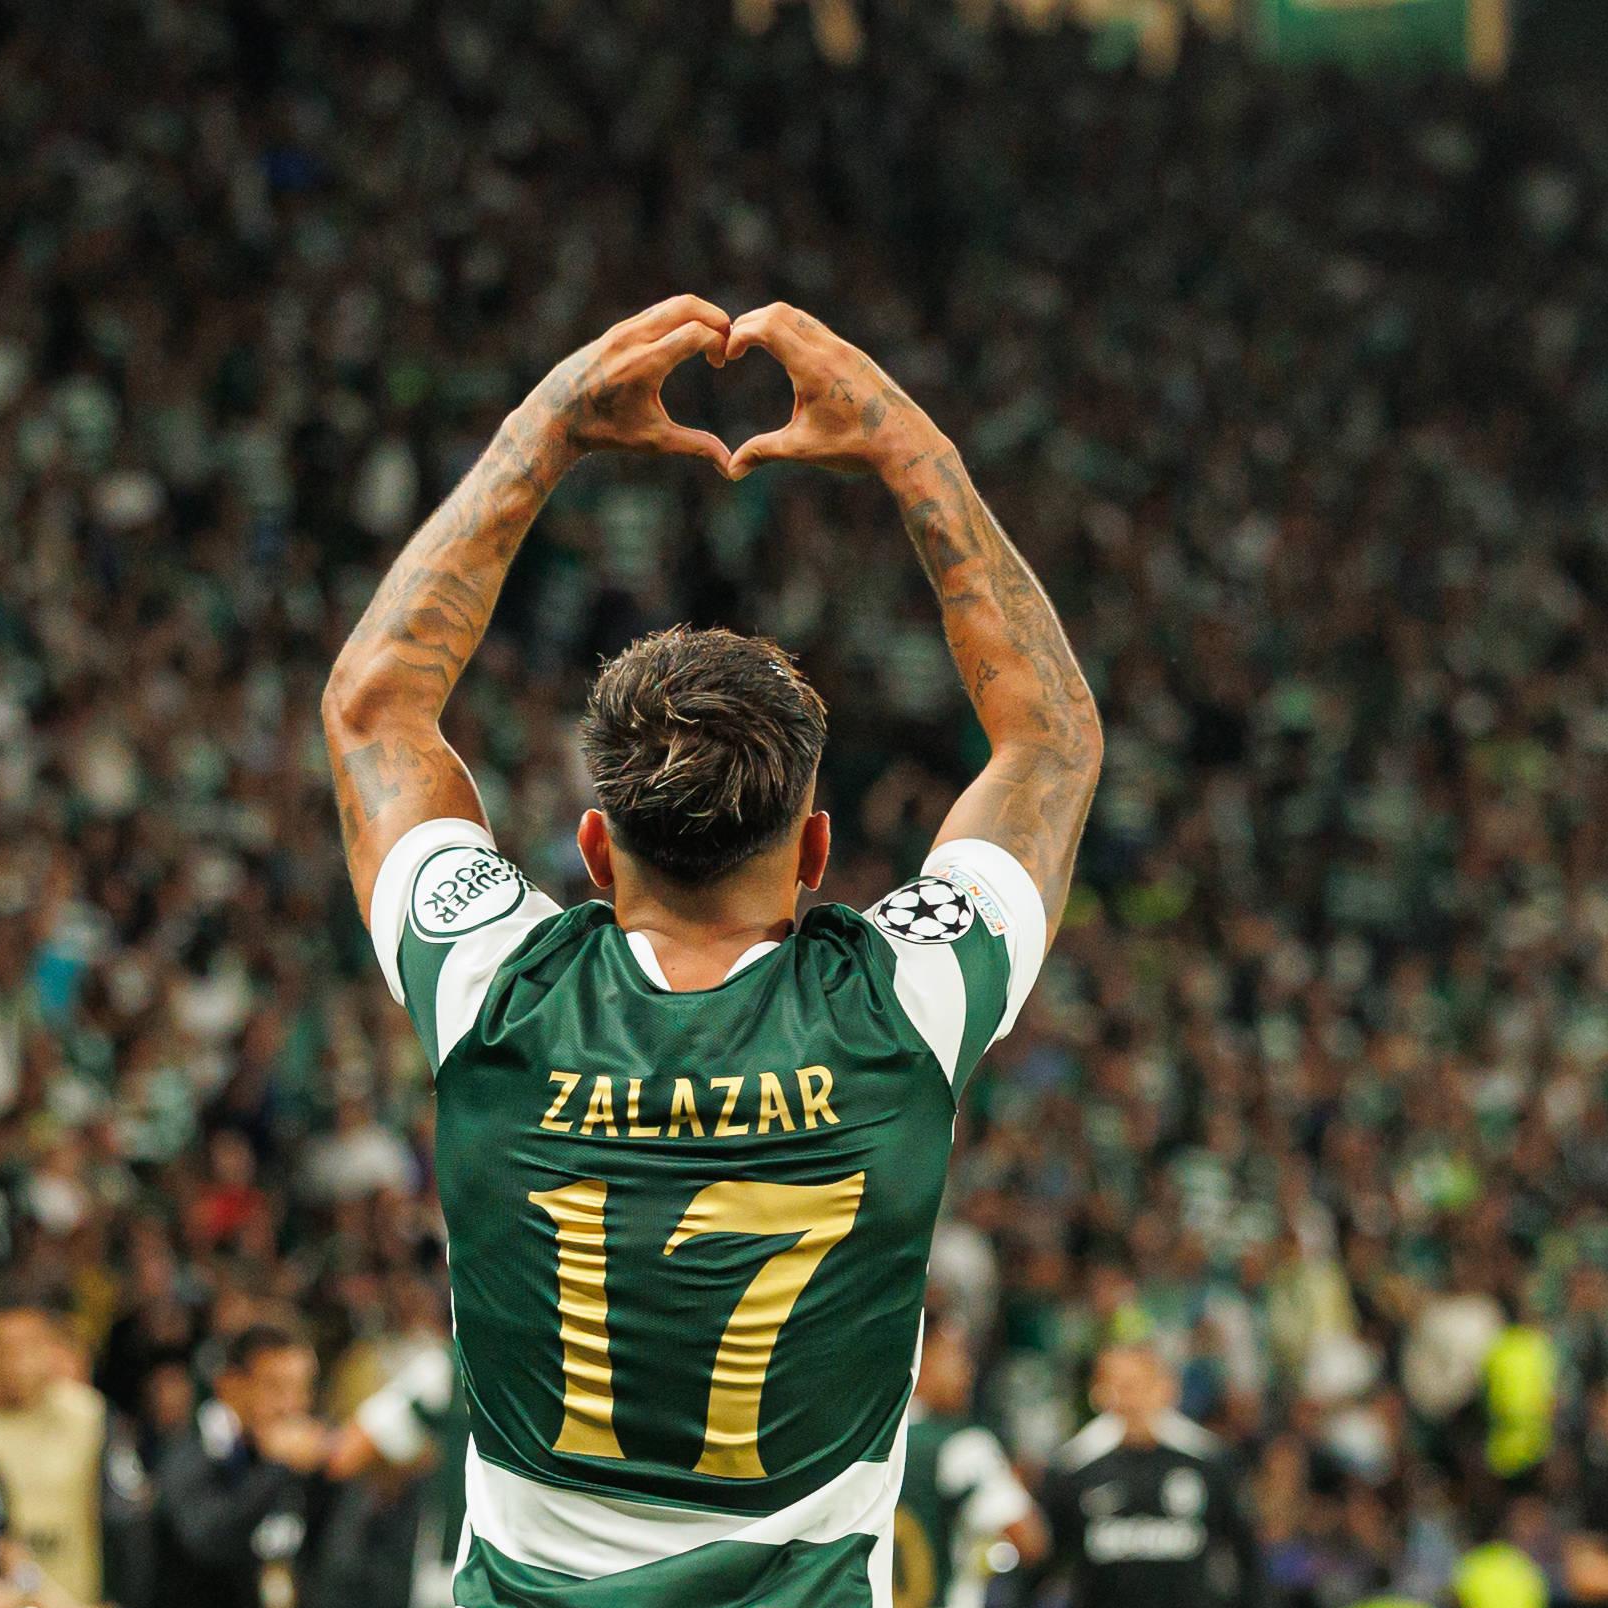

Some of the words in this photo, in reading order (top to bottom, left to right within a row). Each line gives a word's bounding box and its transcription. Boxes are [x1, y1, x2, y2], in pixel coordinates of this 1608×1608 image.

[423, 859, 491, 912] BOCK
[434, 866, 511, 924] SUPER
[539, 1065, 841, 1138] ZALAZAR
[528, 1171, 866, 1478] 17
